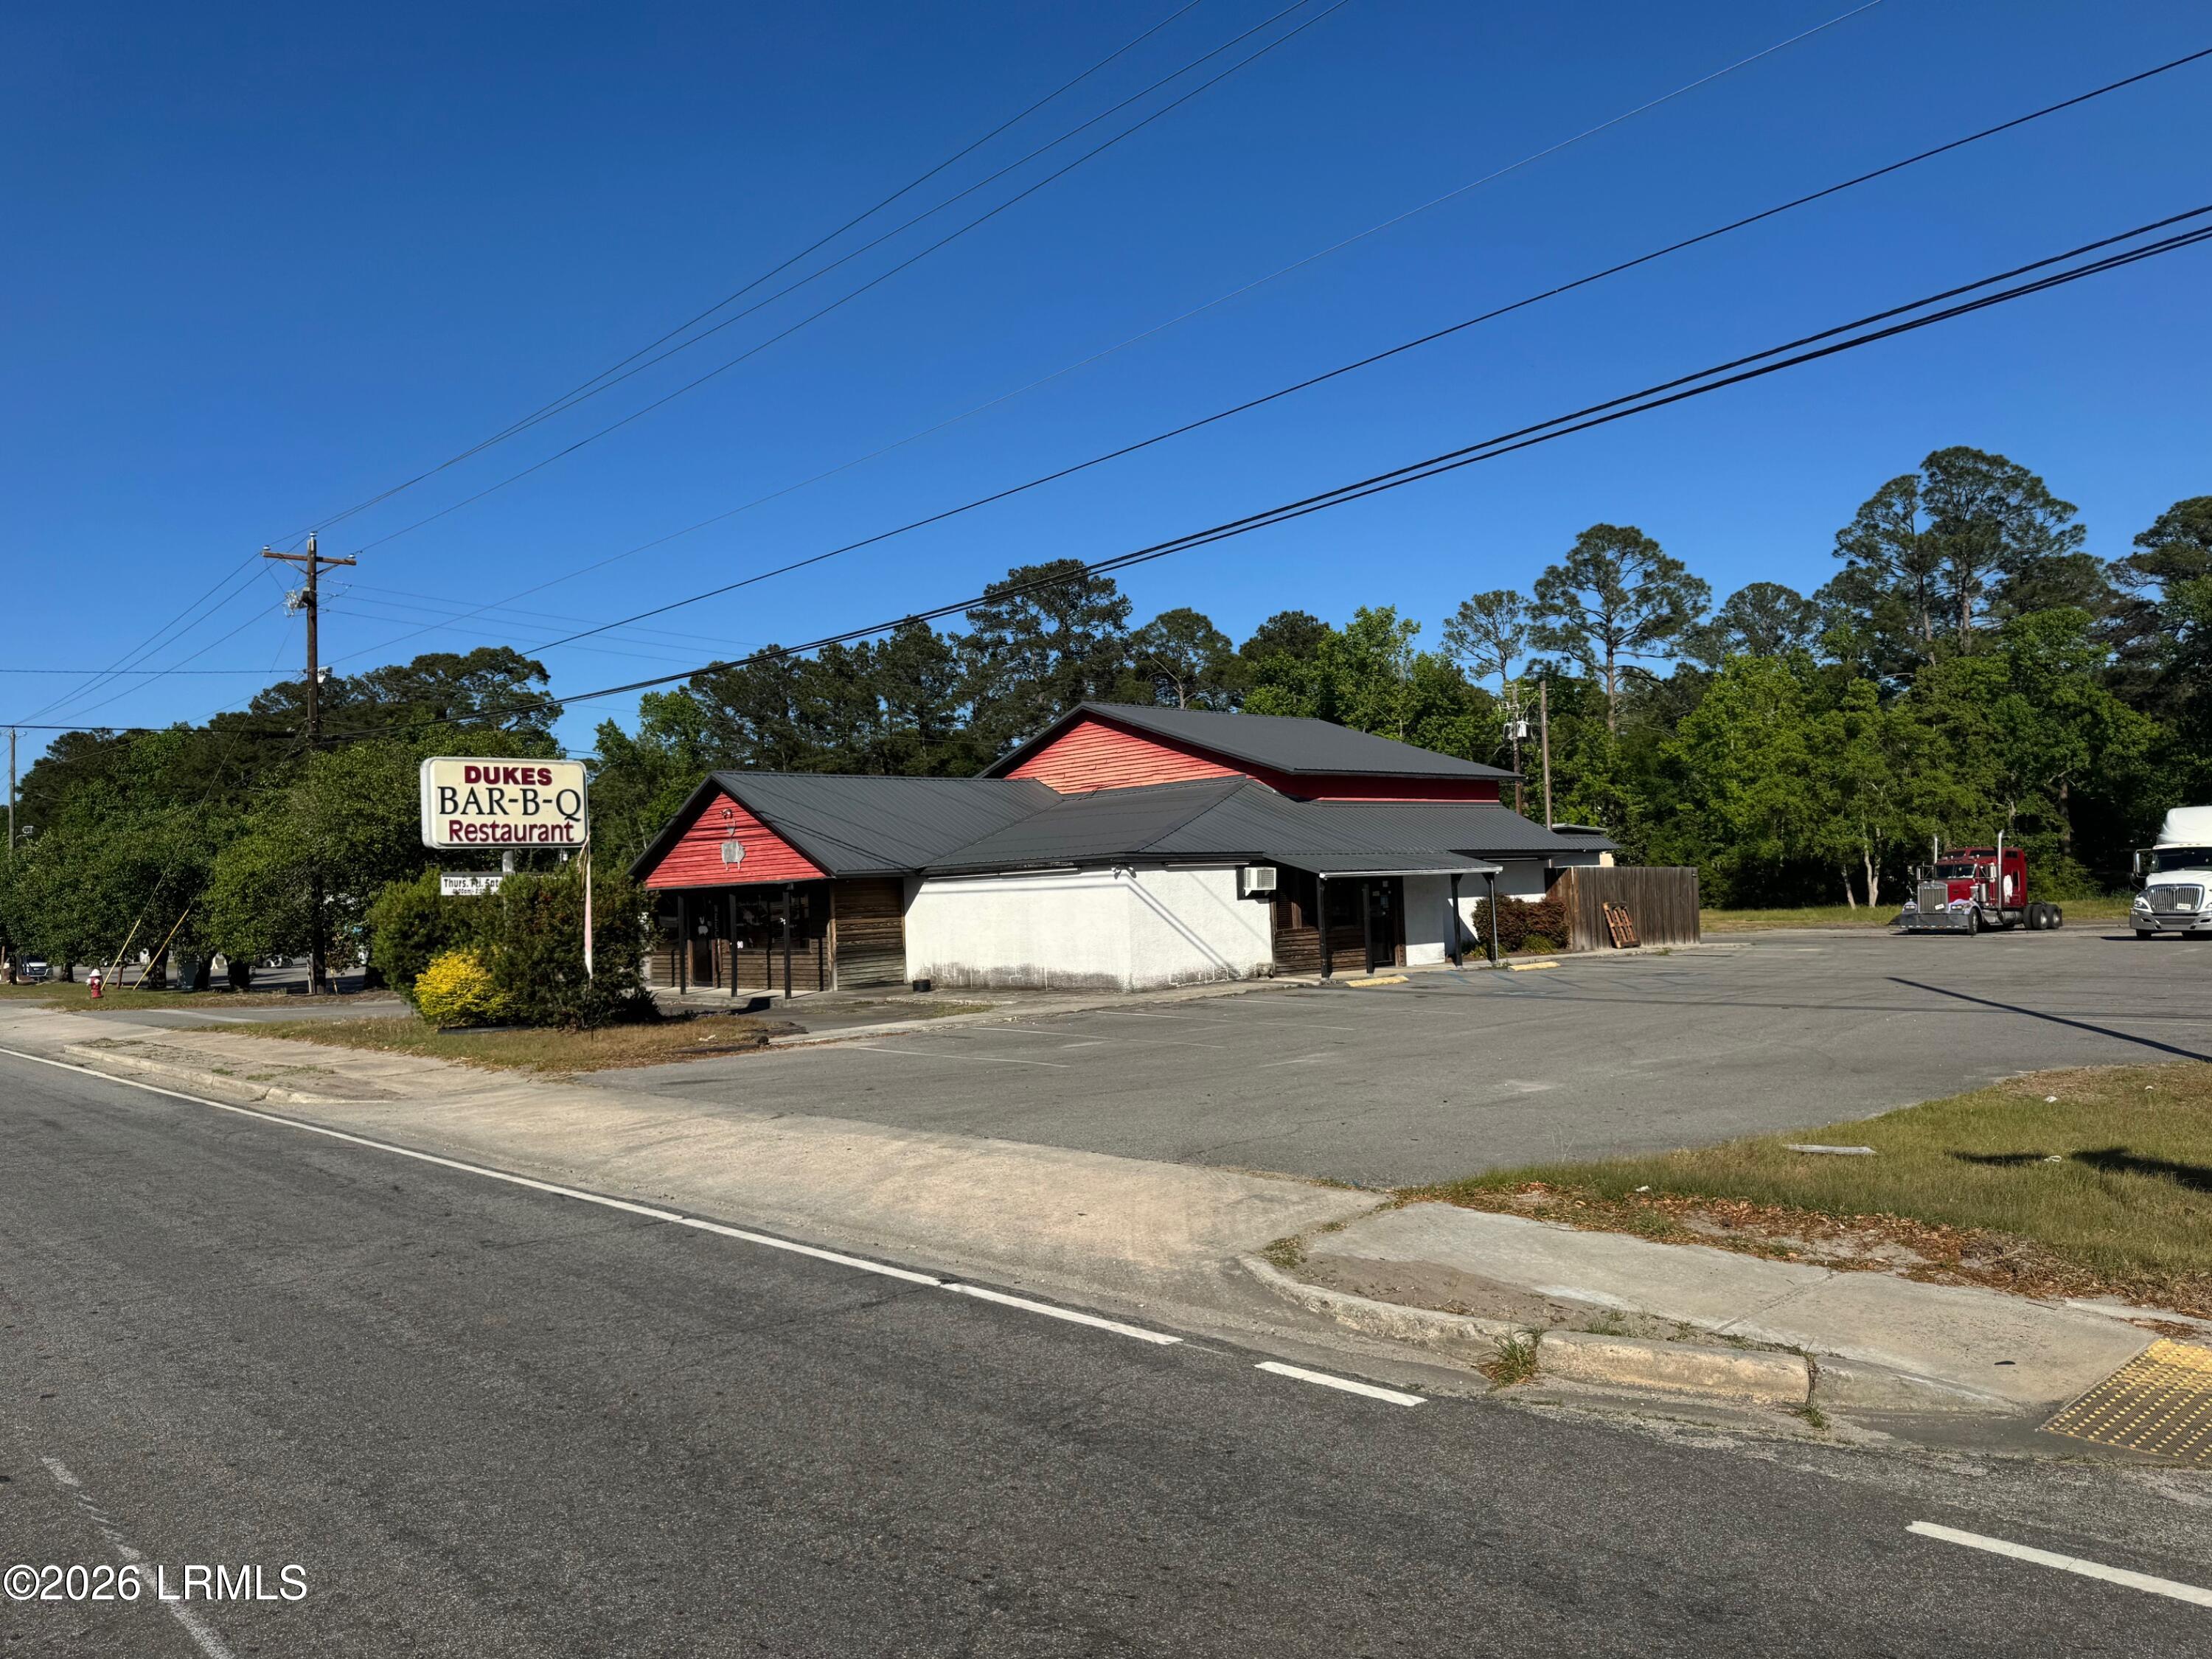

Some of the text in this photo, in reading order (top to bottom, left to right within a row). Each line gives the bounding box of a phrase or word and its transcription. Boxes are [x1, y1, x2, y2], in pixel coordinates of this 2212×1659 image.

[465, 765, 552, 785] DUKES
[437, 786, 581, 822] BAR-B-Q
[448, 819, 574, 842] Restaurant
[444, 878, 468, 888] Thurs.
